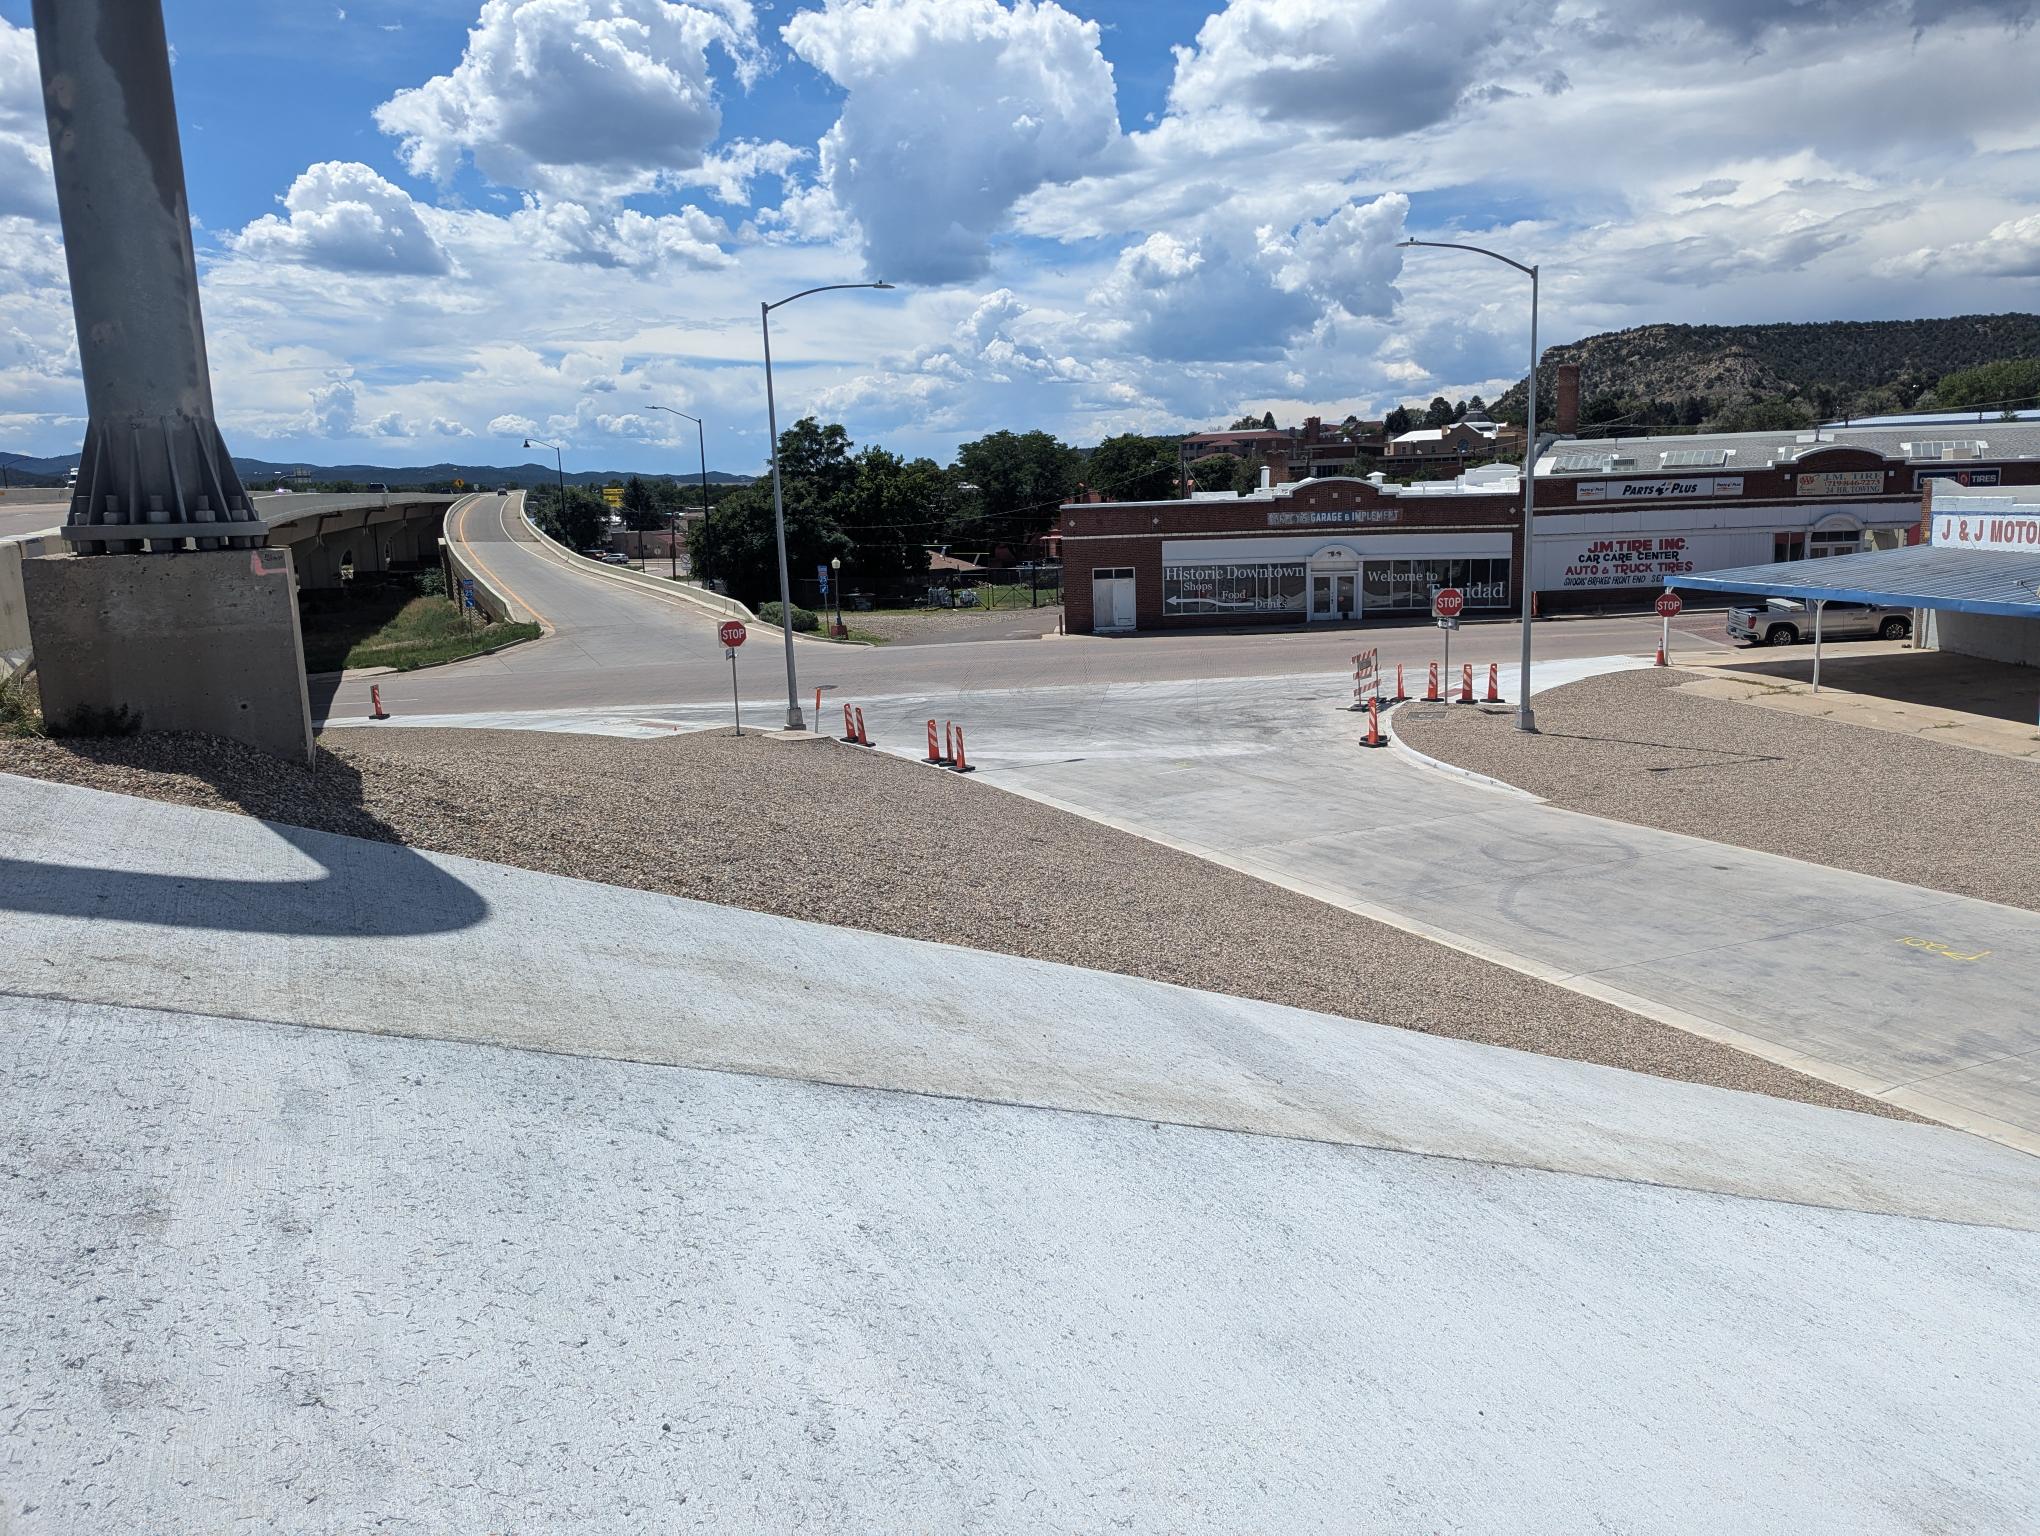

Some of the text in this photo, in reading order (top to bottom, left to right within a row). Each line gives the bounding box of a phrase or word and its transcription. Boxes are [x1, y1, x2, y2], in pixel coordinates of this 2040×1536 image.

[1972, 475, 1997, 483] TIRES
[1622, 483, 1698, 495] PARTS PLUS
[1310, 512, 1342, 522] GARAGE
[1352, 510, 1399, 521] IMPLEMENT
[1942, 520, 2040, 544] J & J MOTO
[1659, 538, 1690, 550] INC.
[1579, 551, 1679, 564] CAR CARE CENTER
[1166, 566, 1304, 580] Historic Downtown
[1565, 565, 1598, 576] AUTO
[1613, 562, 1653, 575] TRUCK
[1659, 561, 1694, 573] TIRES
[1368, 570, 1438, 581] Welcome to
[1588, 576, 1611, 586] BRAKES
[1611, 575, 1631, 585] FRONT
[1632, 575, 1646, 583] END
[1183, 582, 1213, 592] Shops
[1222, 590, 1246, 600] Food
[1255, 600, 1287, 609] Drinks
[1437, 598, 1461, 608] STOP
[1658, 600, 1680, 611] STOP
[722, 628, 745, 640] STOP
